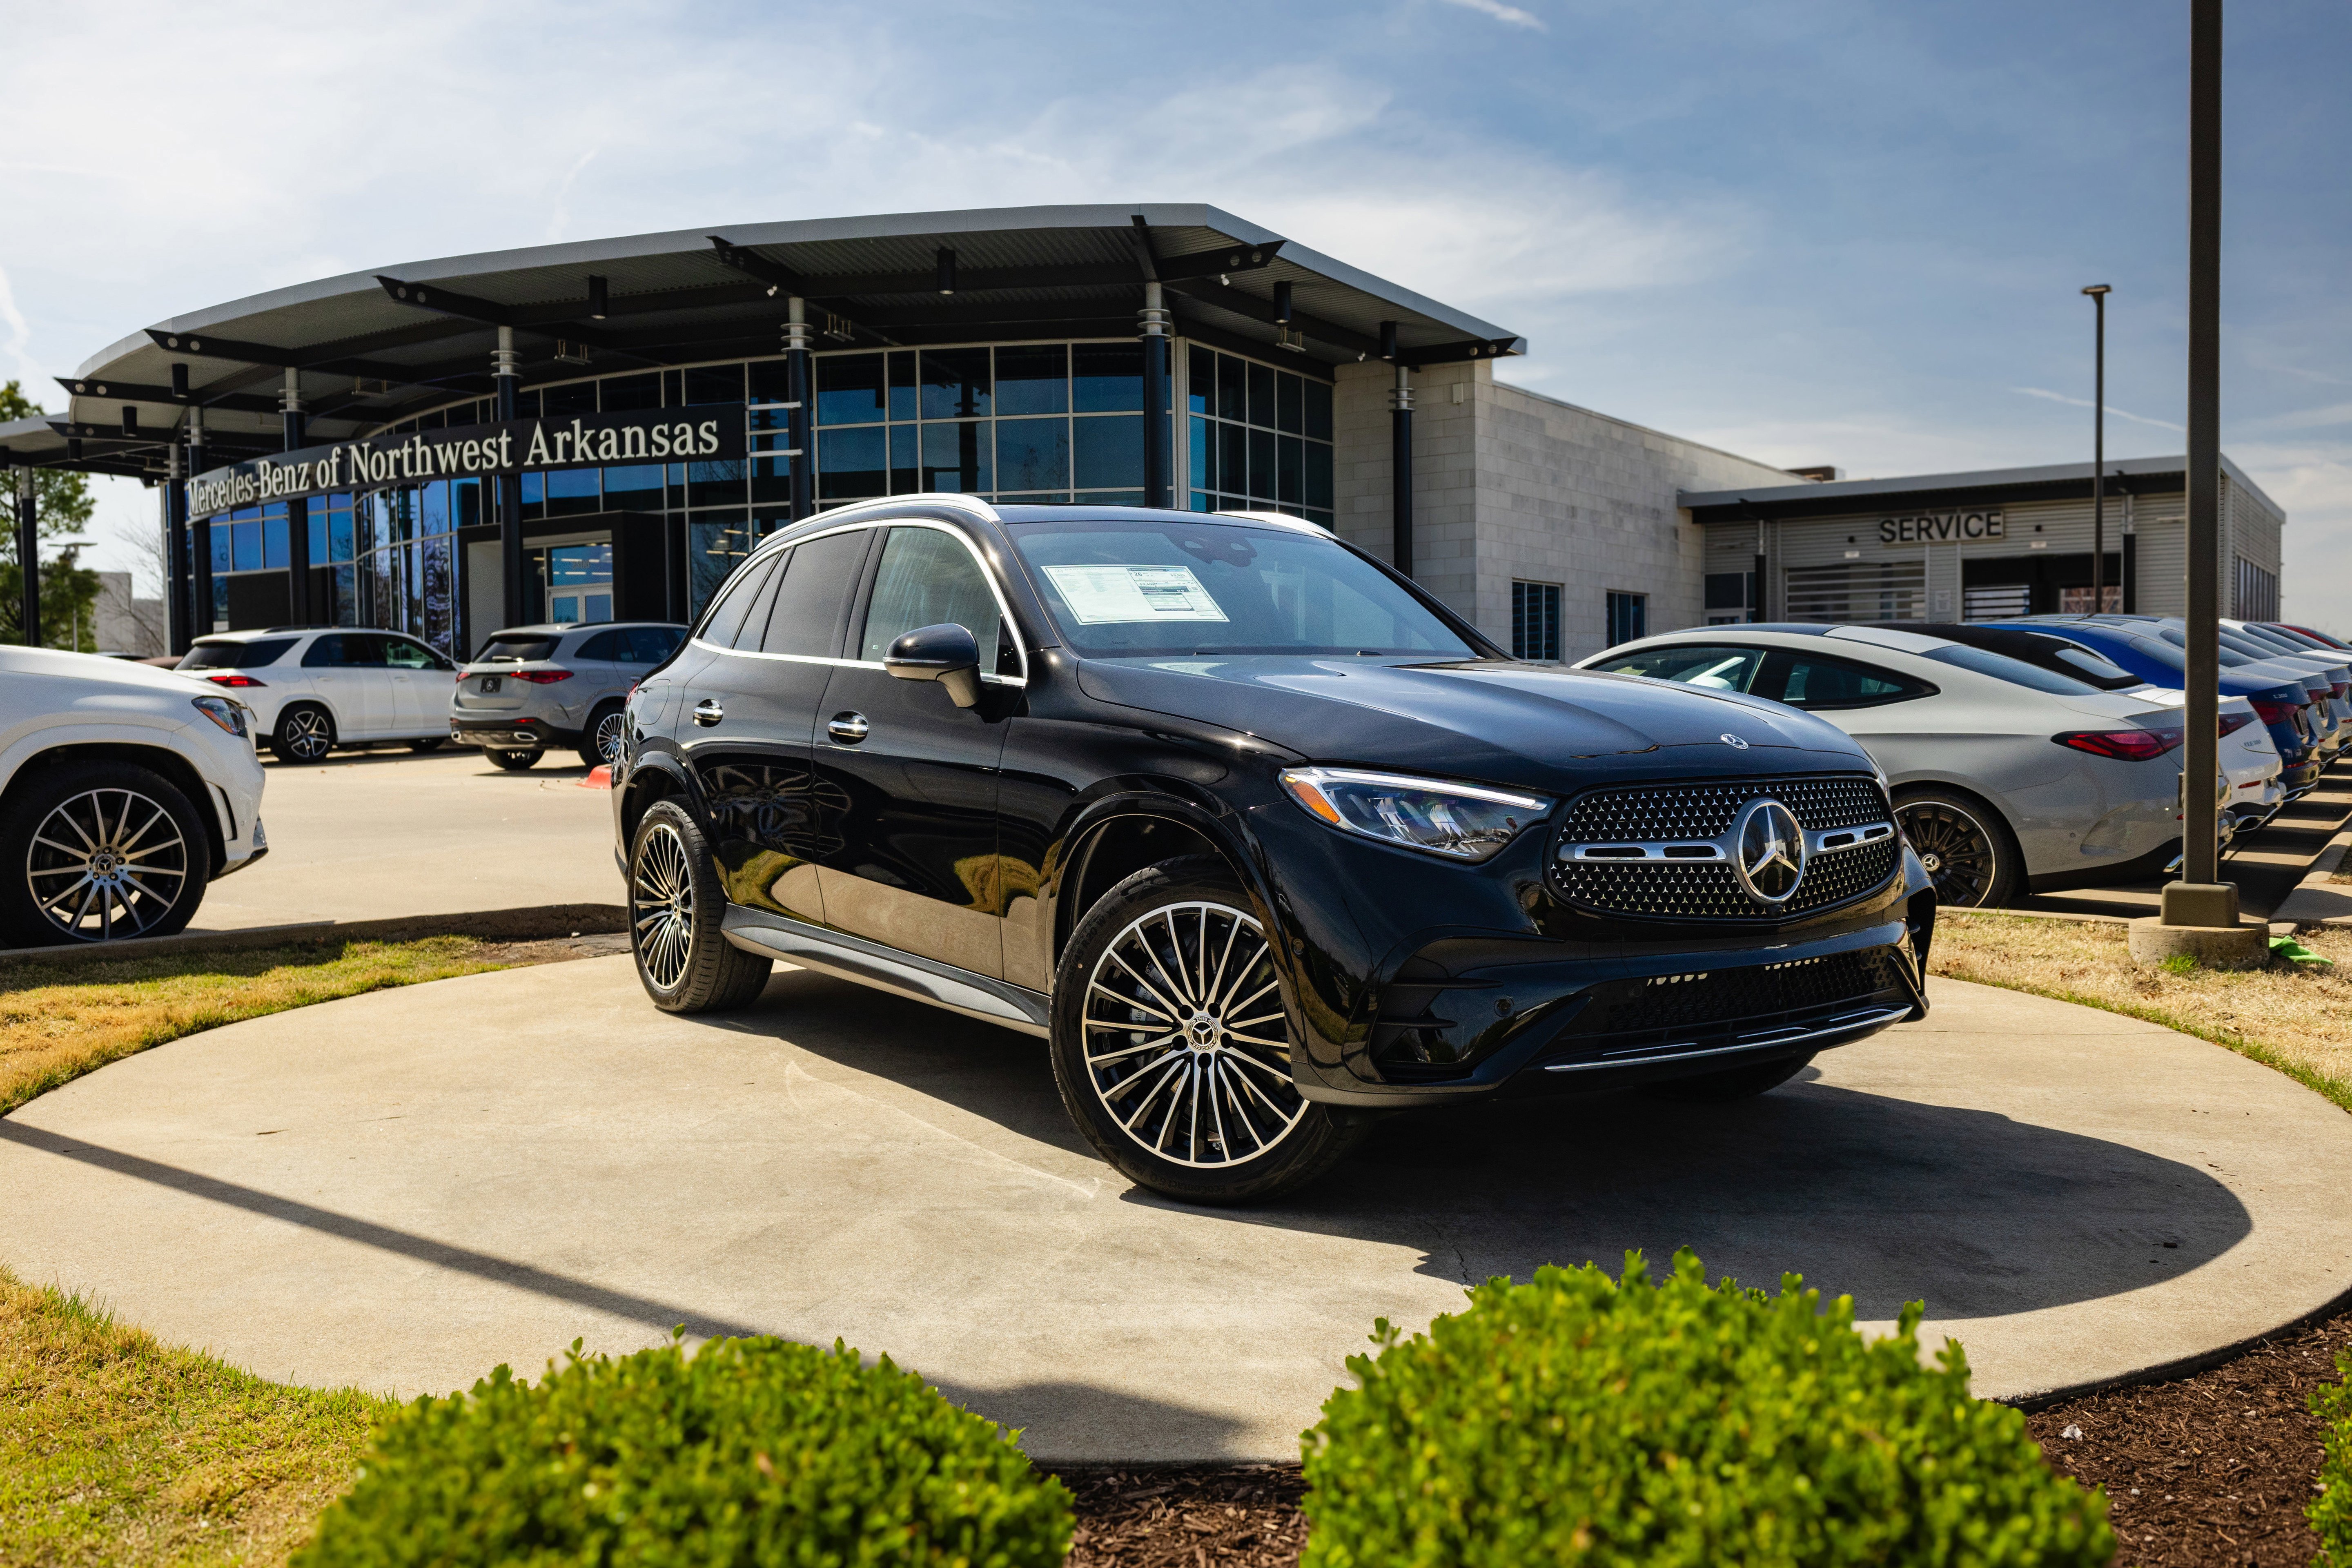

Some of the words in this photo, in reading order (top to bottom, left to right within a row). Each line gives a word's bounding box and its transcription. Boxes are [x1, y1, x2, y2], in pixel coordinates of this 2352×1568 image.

[187, 459, 310, 517] Mercedes-Benz
[316, 445, 341, 489] of
[349, 429, 512, 485] Northwest
[524, 419, 719, 466] Arkansas
[1880, 513, 2002, 543] SERVICE
